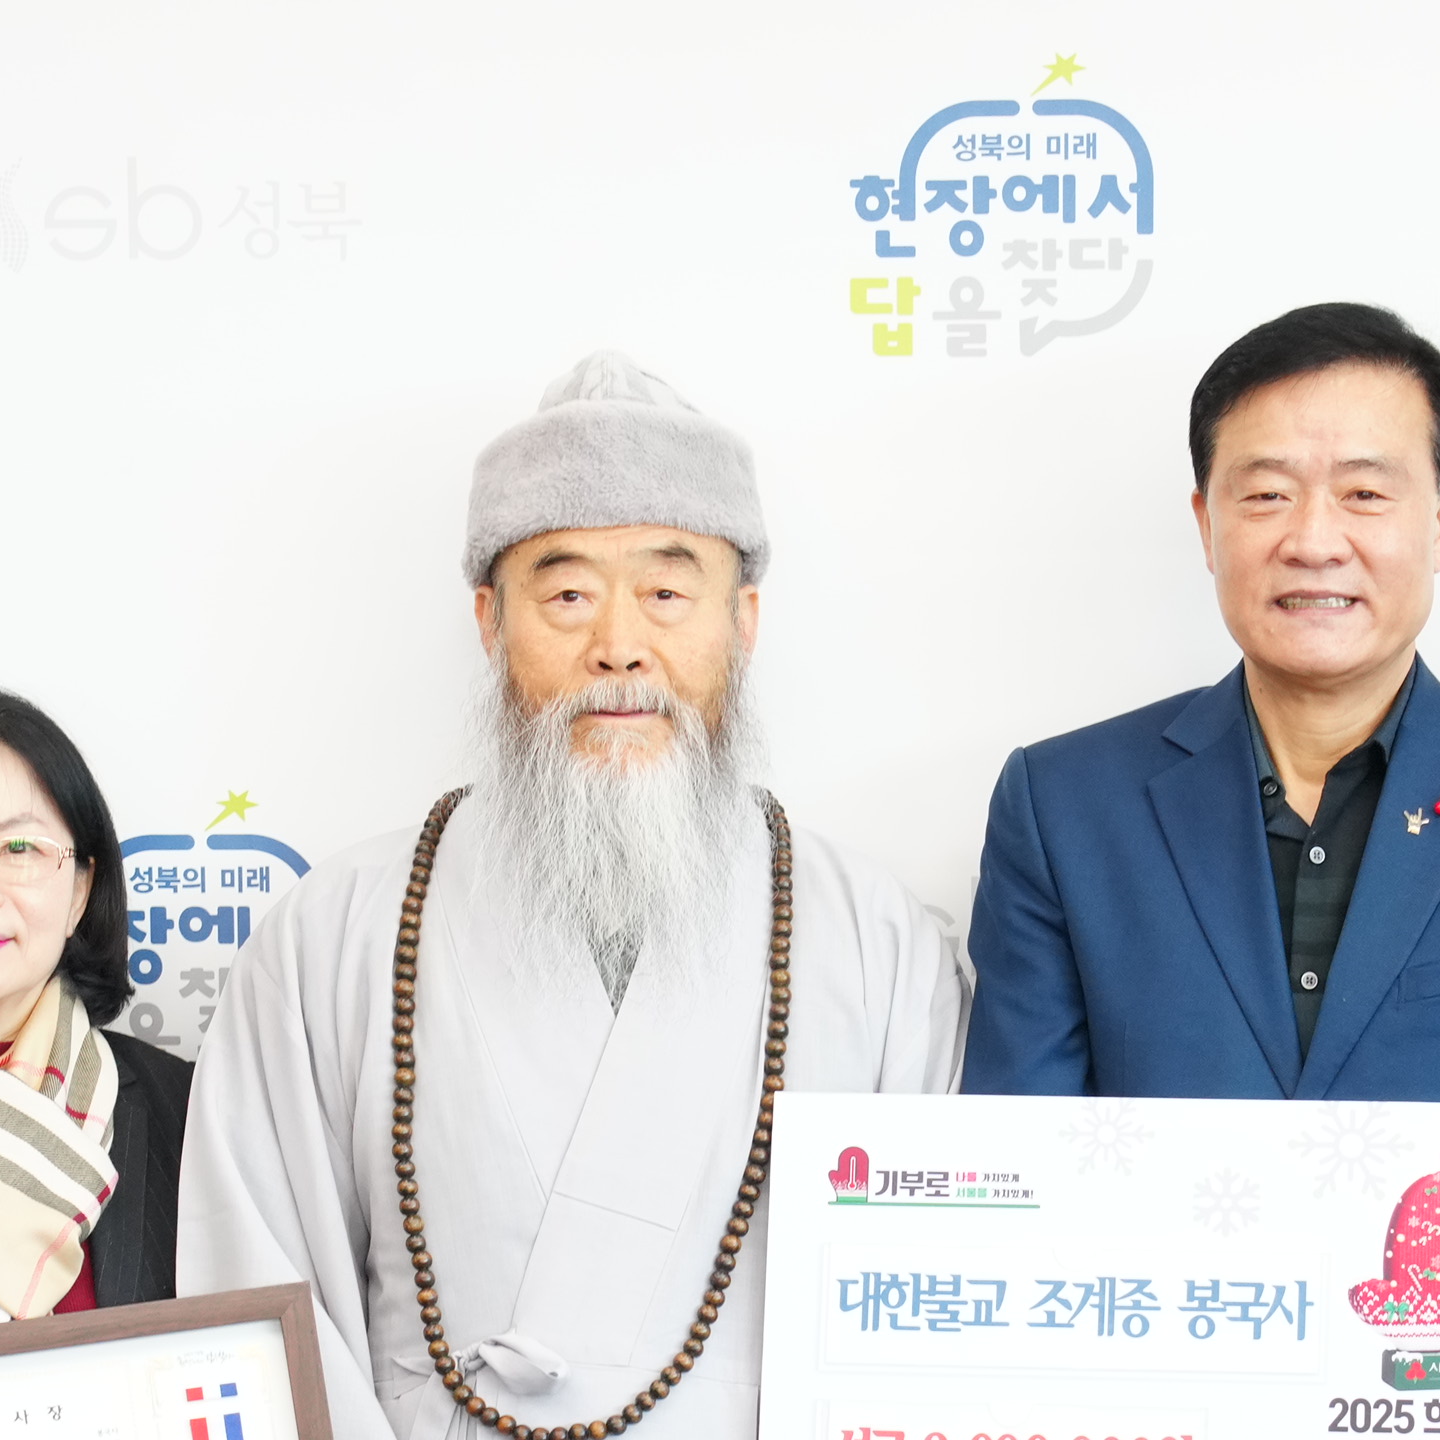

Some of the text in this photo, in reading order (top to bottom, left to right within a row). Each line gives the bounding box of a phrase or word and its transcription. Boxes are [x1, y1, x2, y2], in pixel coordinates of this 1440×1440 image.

[952, 132, 1097, 161] 성북의 미래
[44, 156, 363, 261] sb 성북
[849, 174, 1154, 258] 현장에서
[849, 237, 1129, 357] 답을 찾다
[129, 866, 271, 893] 성북의 미래
[875, 1170, 950, 1197] 기부로
[836, 1271, 1314, 1341] 대한불교 조계종 봉국사
[13, 1408, 29, 1425] 사
[47, 1404, 63, 1422] 장
[1327, 1398, 1415, 1434] 2025
